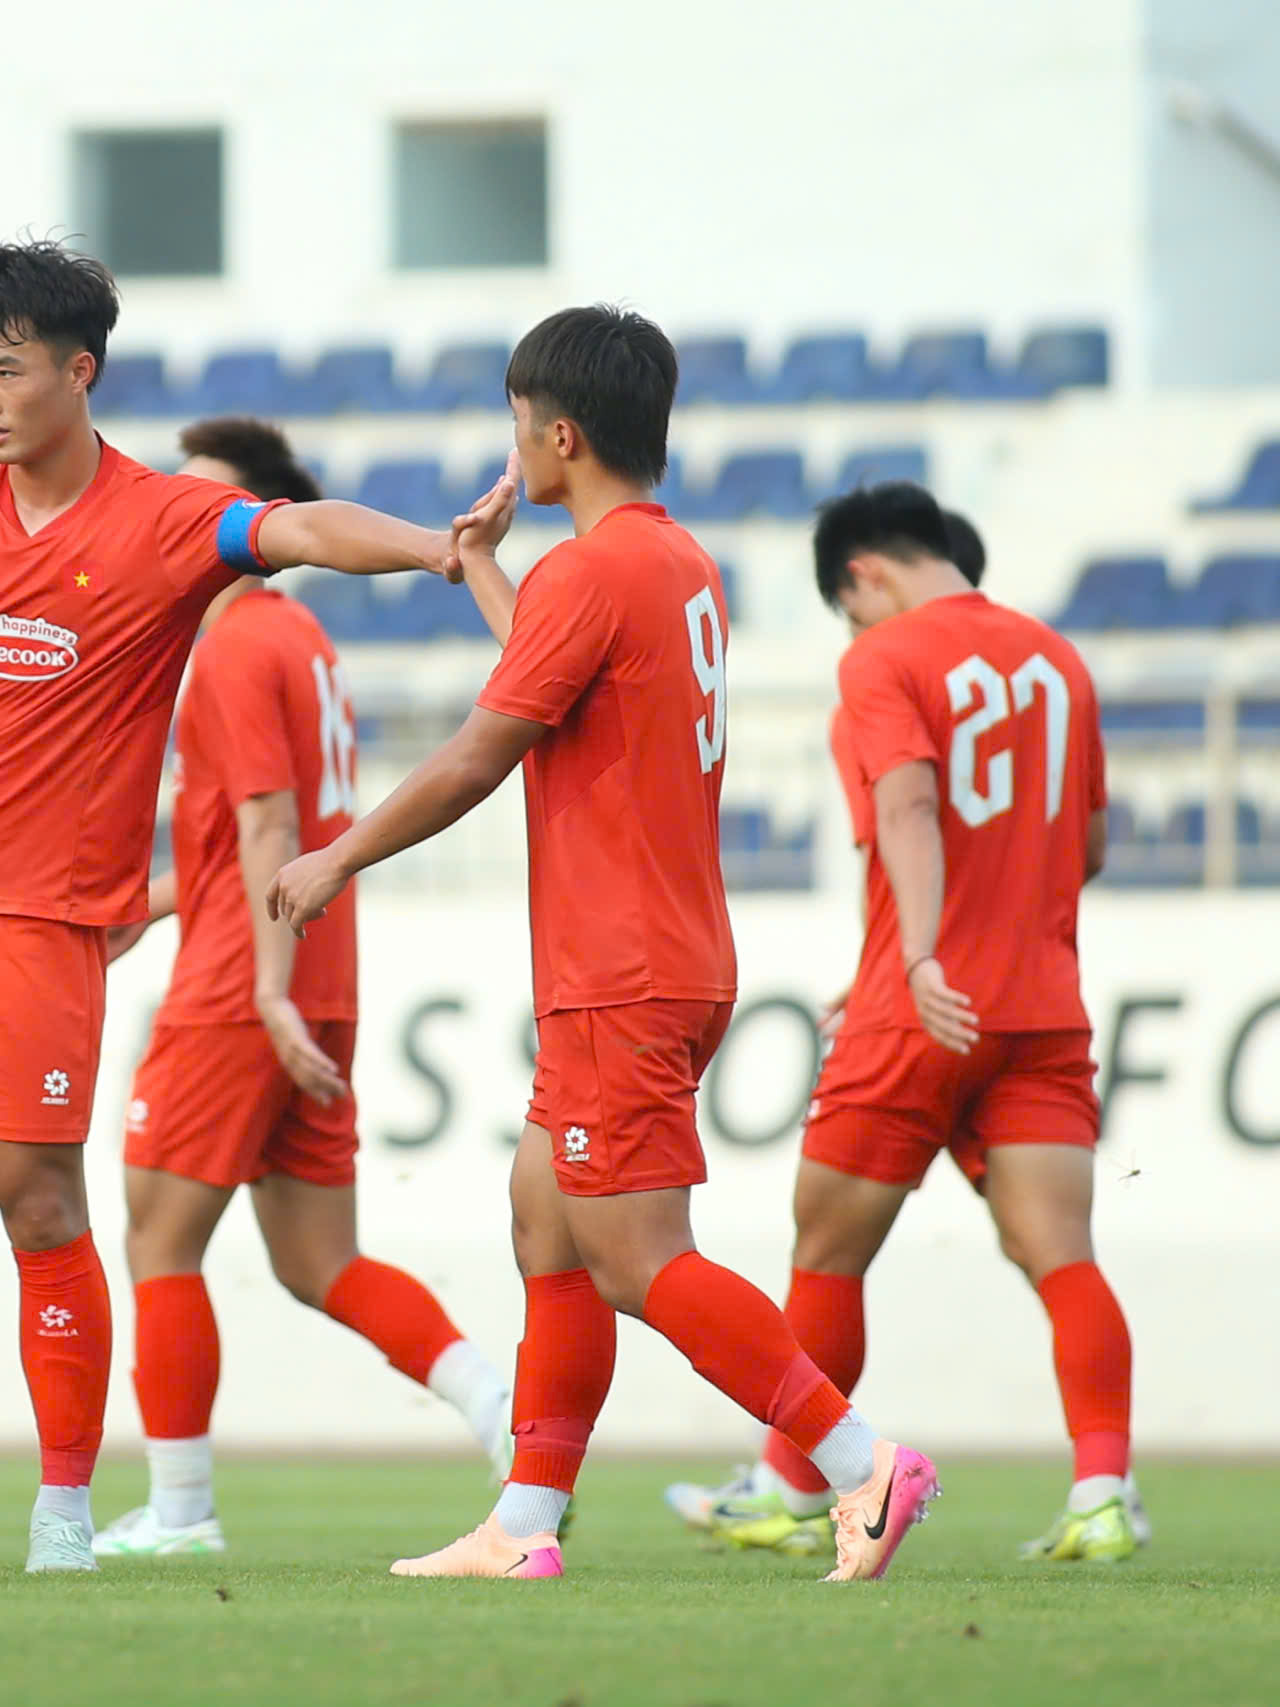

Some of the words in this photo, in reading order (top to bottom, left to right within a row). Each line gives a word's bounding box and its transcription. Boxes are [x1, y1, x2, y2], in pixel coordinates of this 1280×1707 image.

[1, 616, 76, 644] happiness
[684, 585, 728, 775] 9
[944, 652, 1070, 829] 27
